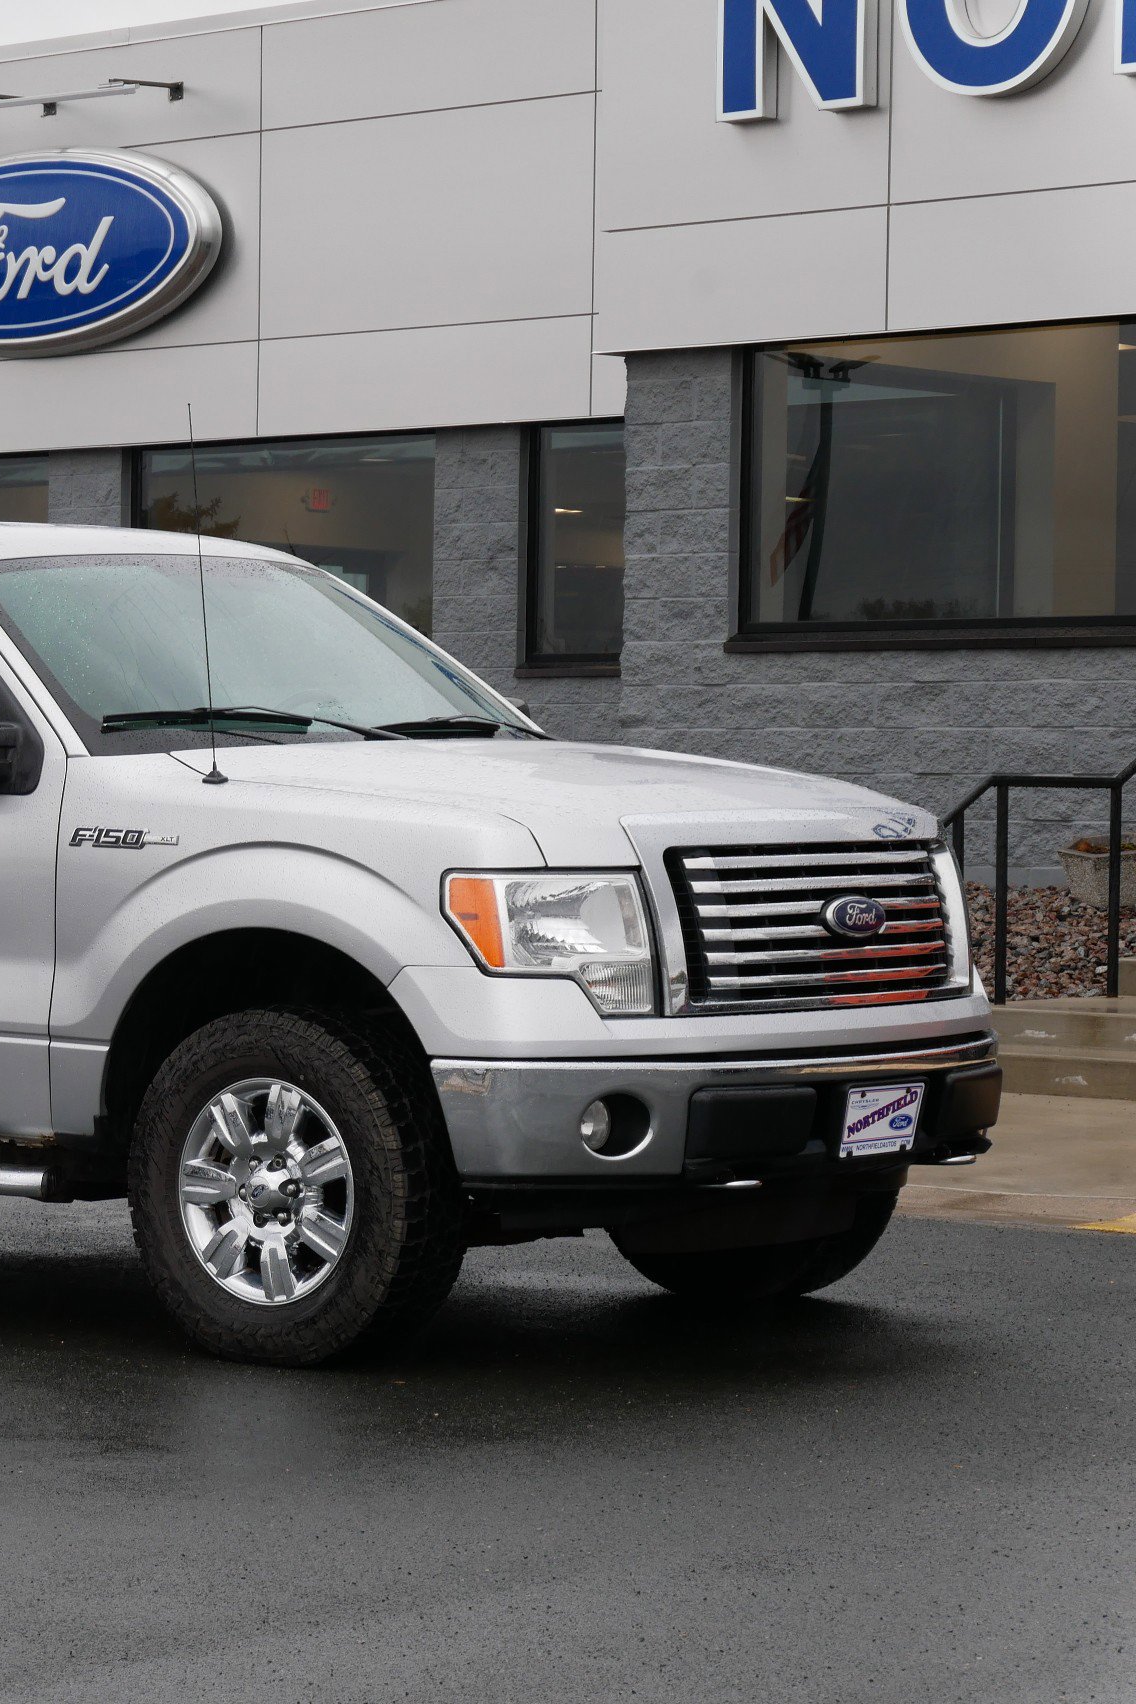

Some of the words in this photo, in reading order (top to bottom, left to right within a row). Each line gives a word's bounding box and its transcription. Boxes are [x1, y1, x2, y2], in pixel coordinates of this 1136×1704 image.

[846, 903, 877, 926] Ford
[847, 1090, 918, 1138] NORTHFIELD
[892, 1116, 909, 1128] Ford
